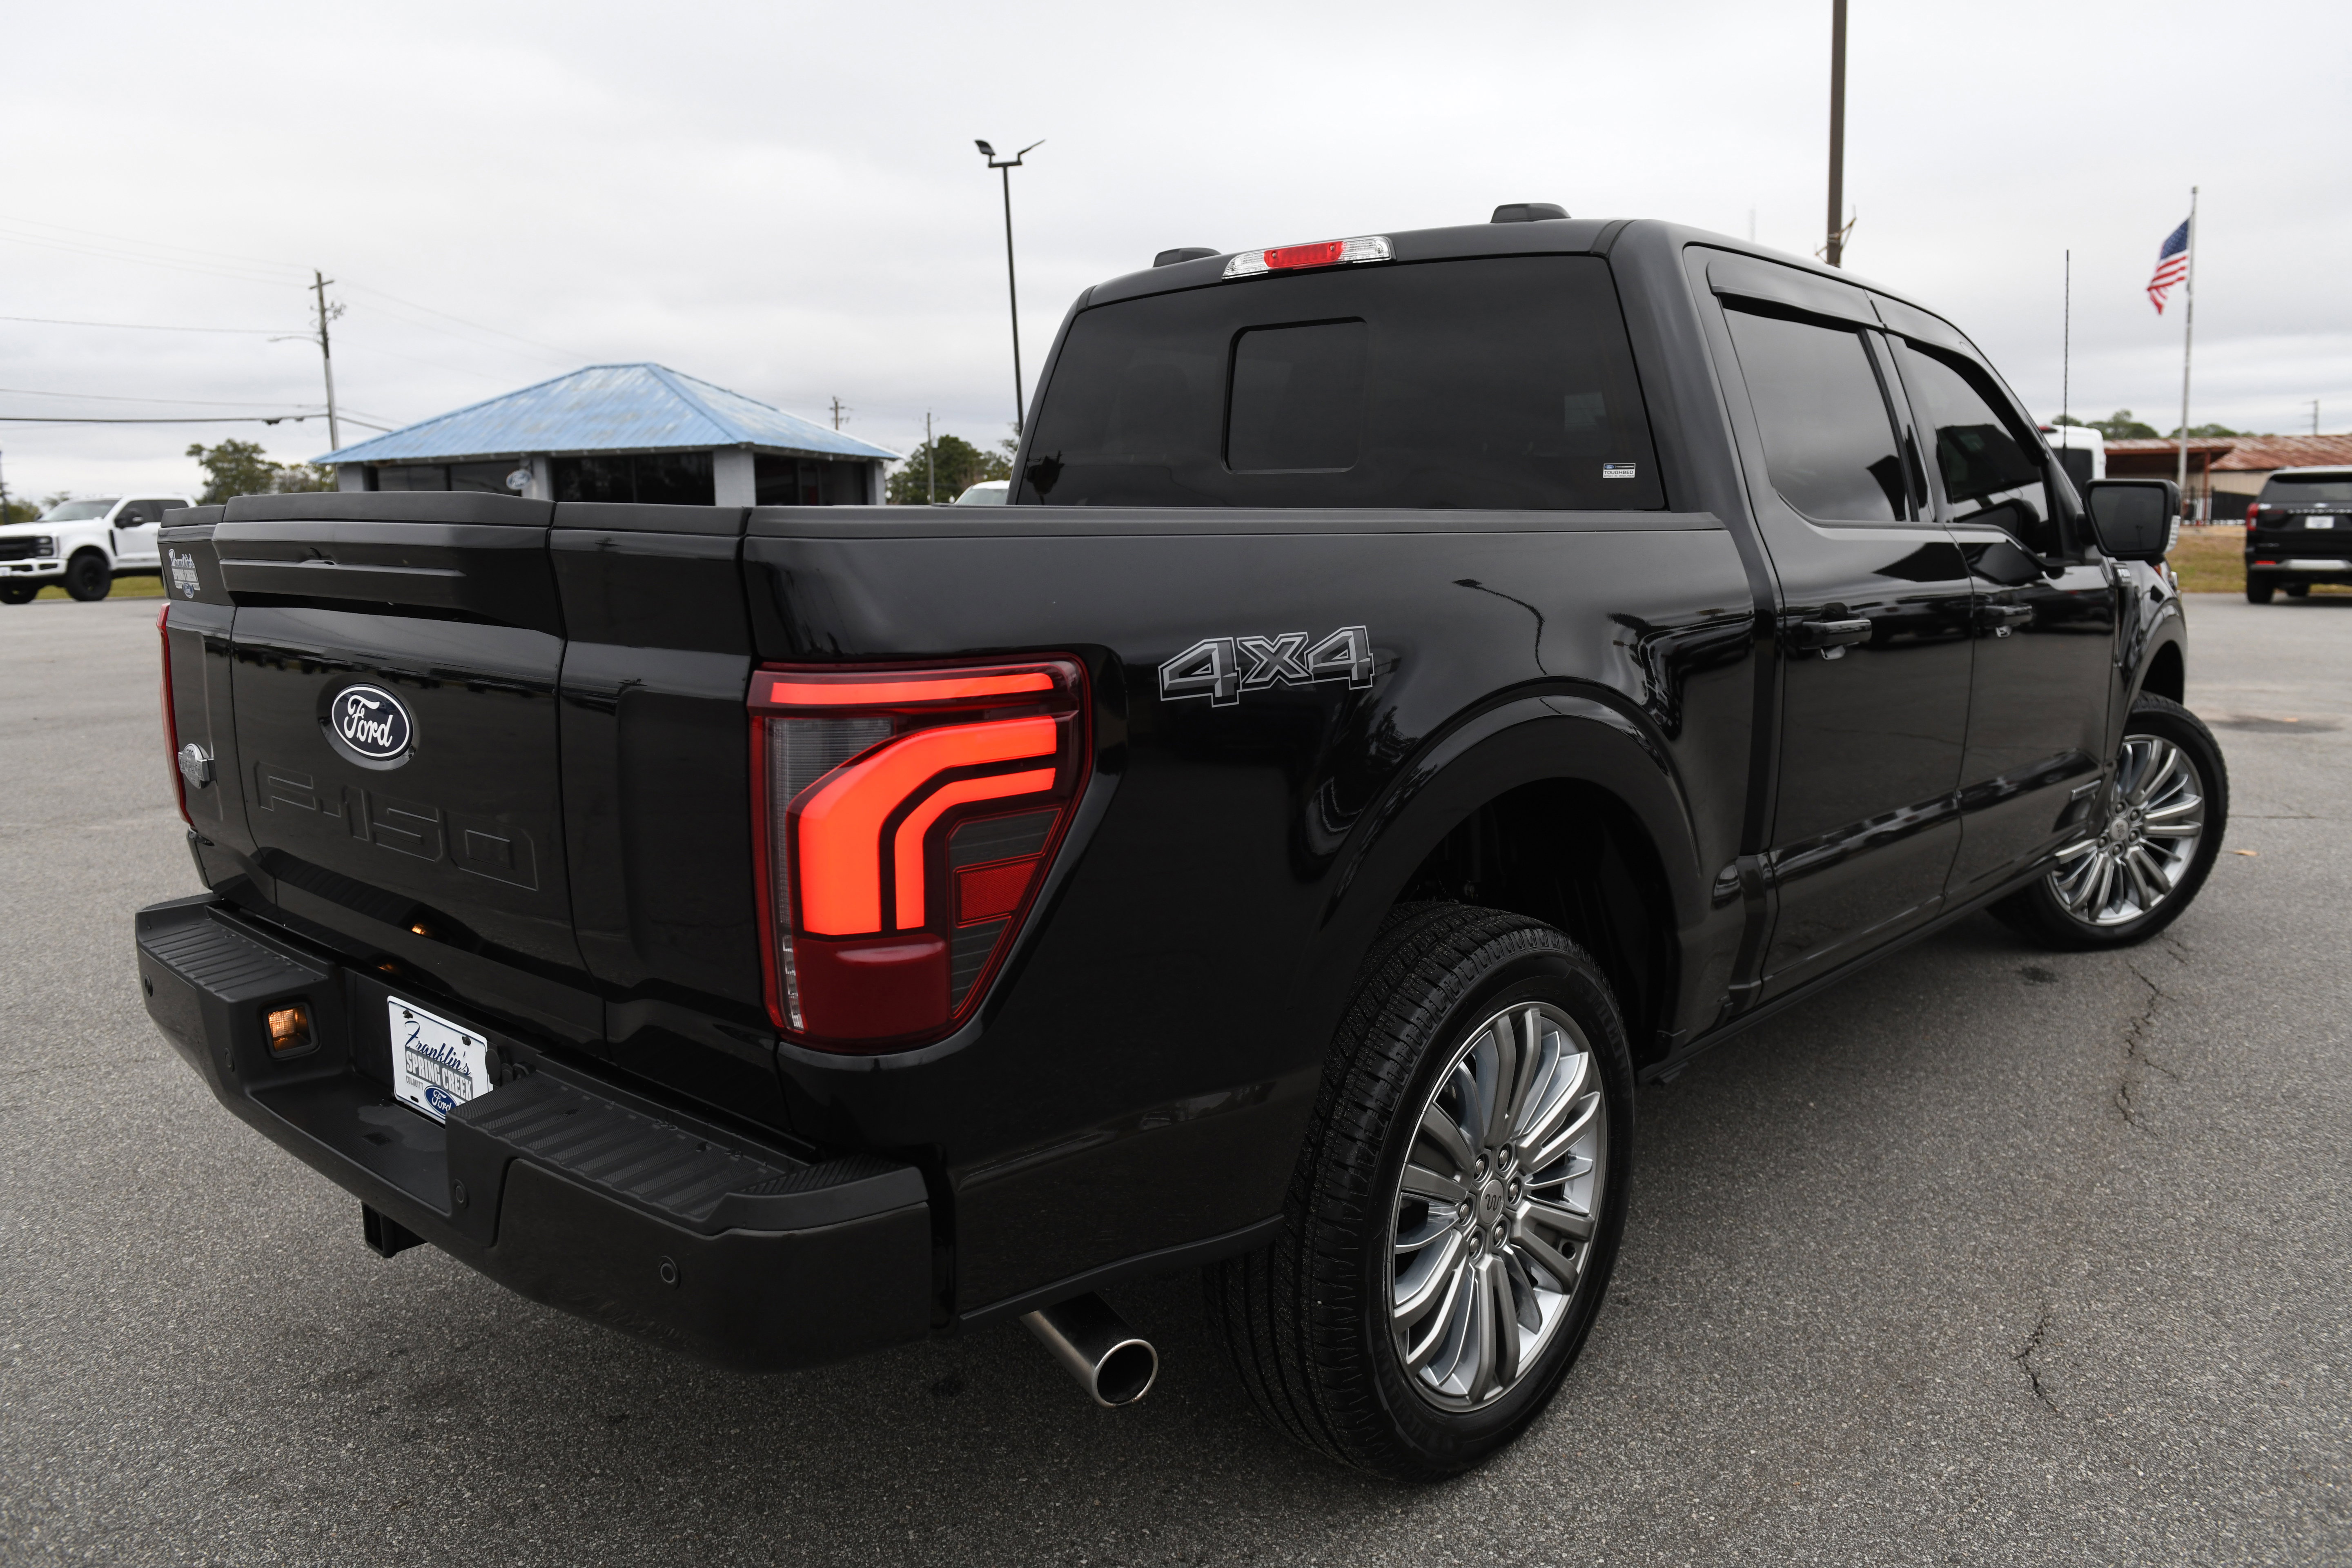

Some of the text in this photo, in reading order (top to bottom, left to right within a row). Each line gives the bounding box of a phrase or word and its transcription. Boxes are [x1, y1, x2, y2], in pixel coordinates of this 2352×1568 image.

[343, 694, 394, 747] Ford
[254, 760, 539, 891] F-150
[404, 1020, 472, 1076] Franklin's
[406, 1050, 472, 1102] SPRING CREEK
[406, 1075, 423, 1091] COLQUITT
[432, 1089, 452, 1112] Ford
